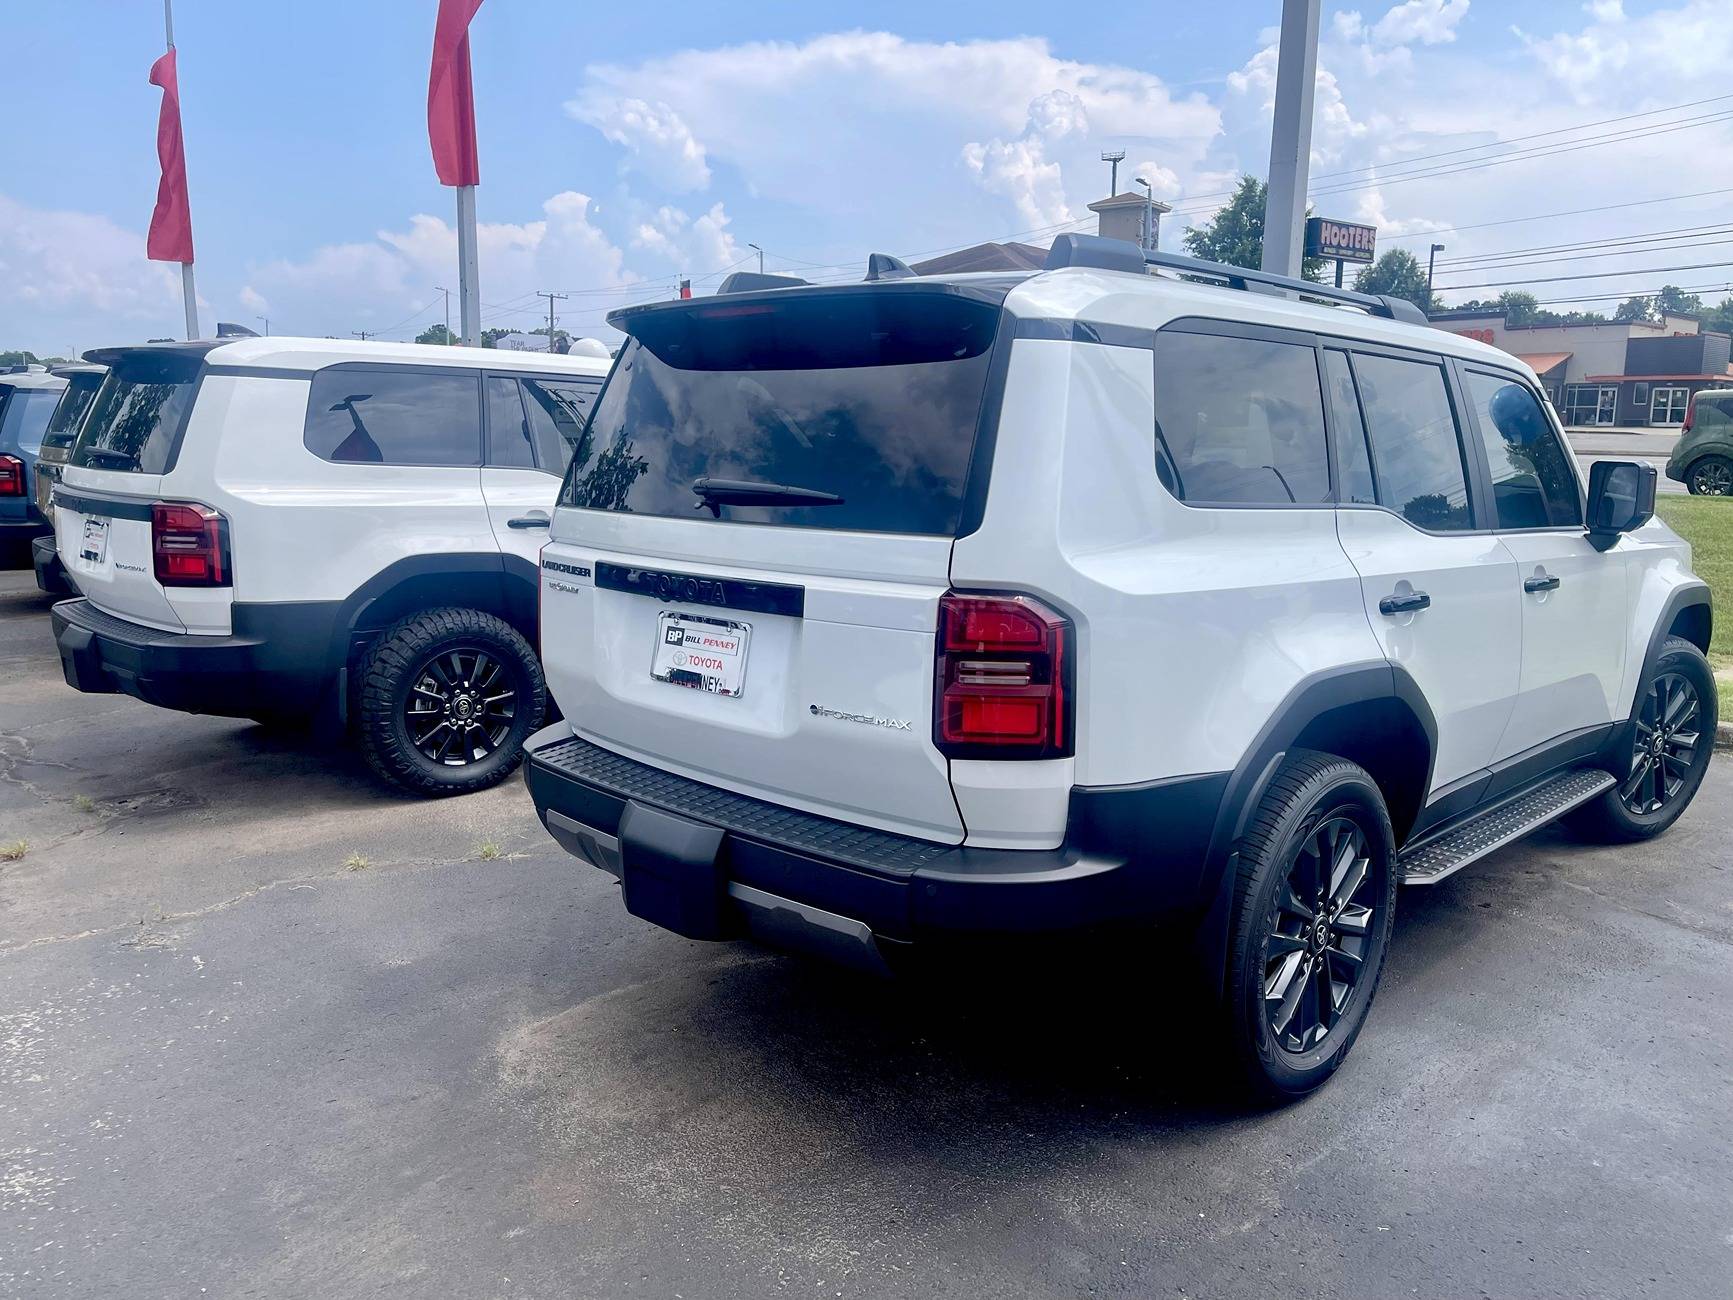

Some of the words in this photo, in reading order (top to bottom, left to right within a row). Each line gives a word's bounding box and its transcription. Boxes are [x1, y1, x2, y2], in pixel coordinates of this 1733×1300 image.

[1320, 222, 1376, 250] HOOTERS
[646, 572, 727, 604] TOYOTA
[666, 630, 683, 642] BP
[684, 635, 701, 644] BILL
[702, 638, 737, 650] PENNEY
[689, 655, 723, 671] TOYOTA
[875, 718, 913, 731] MAX
